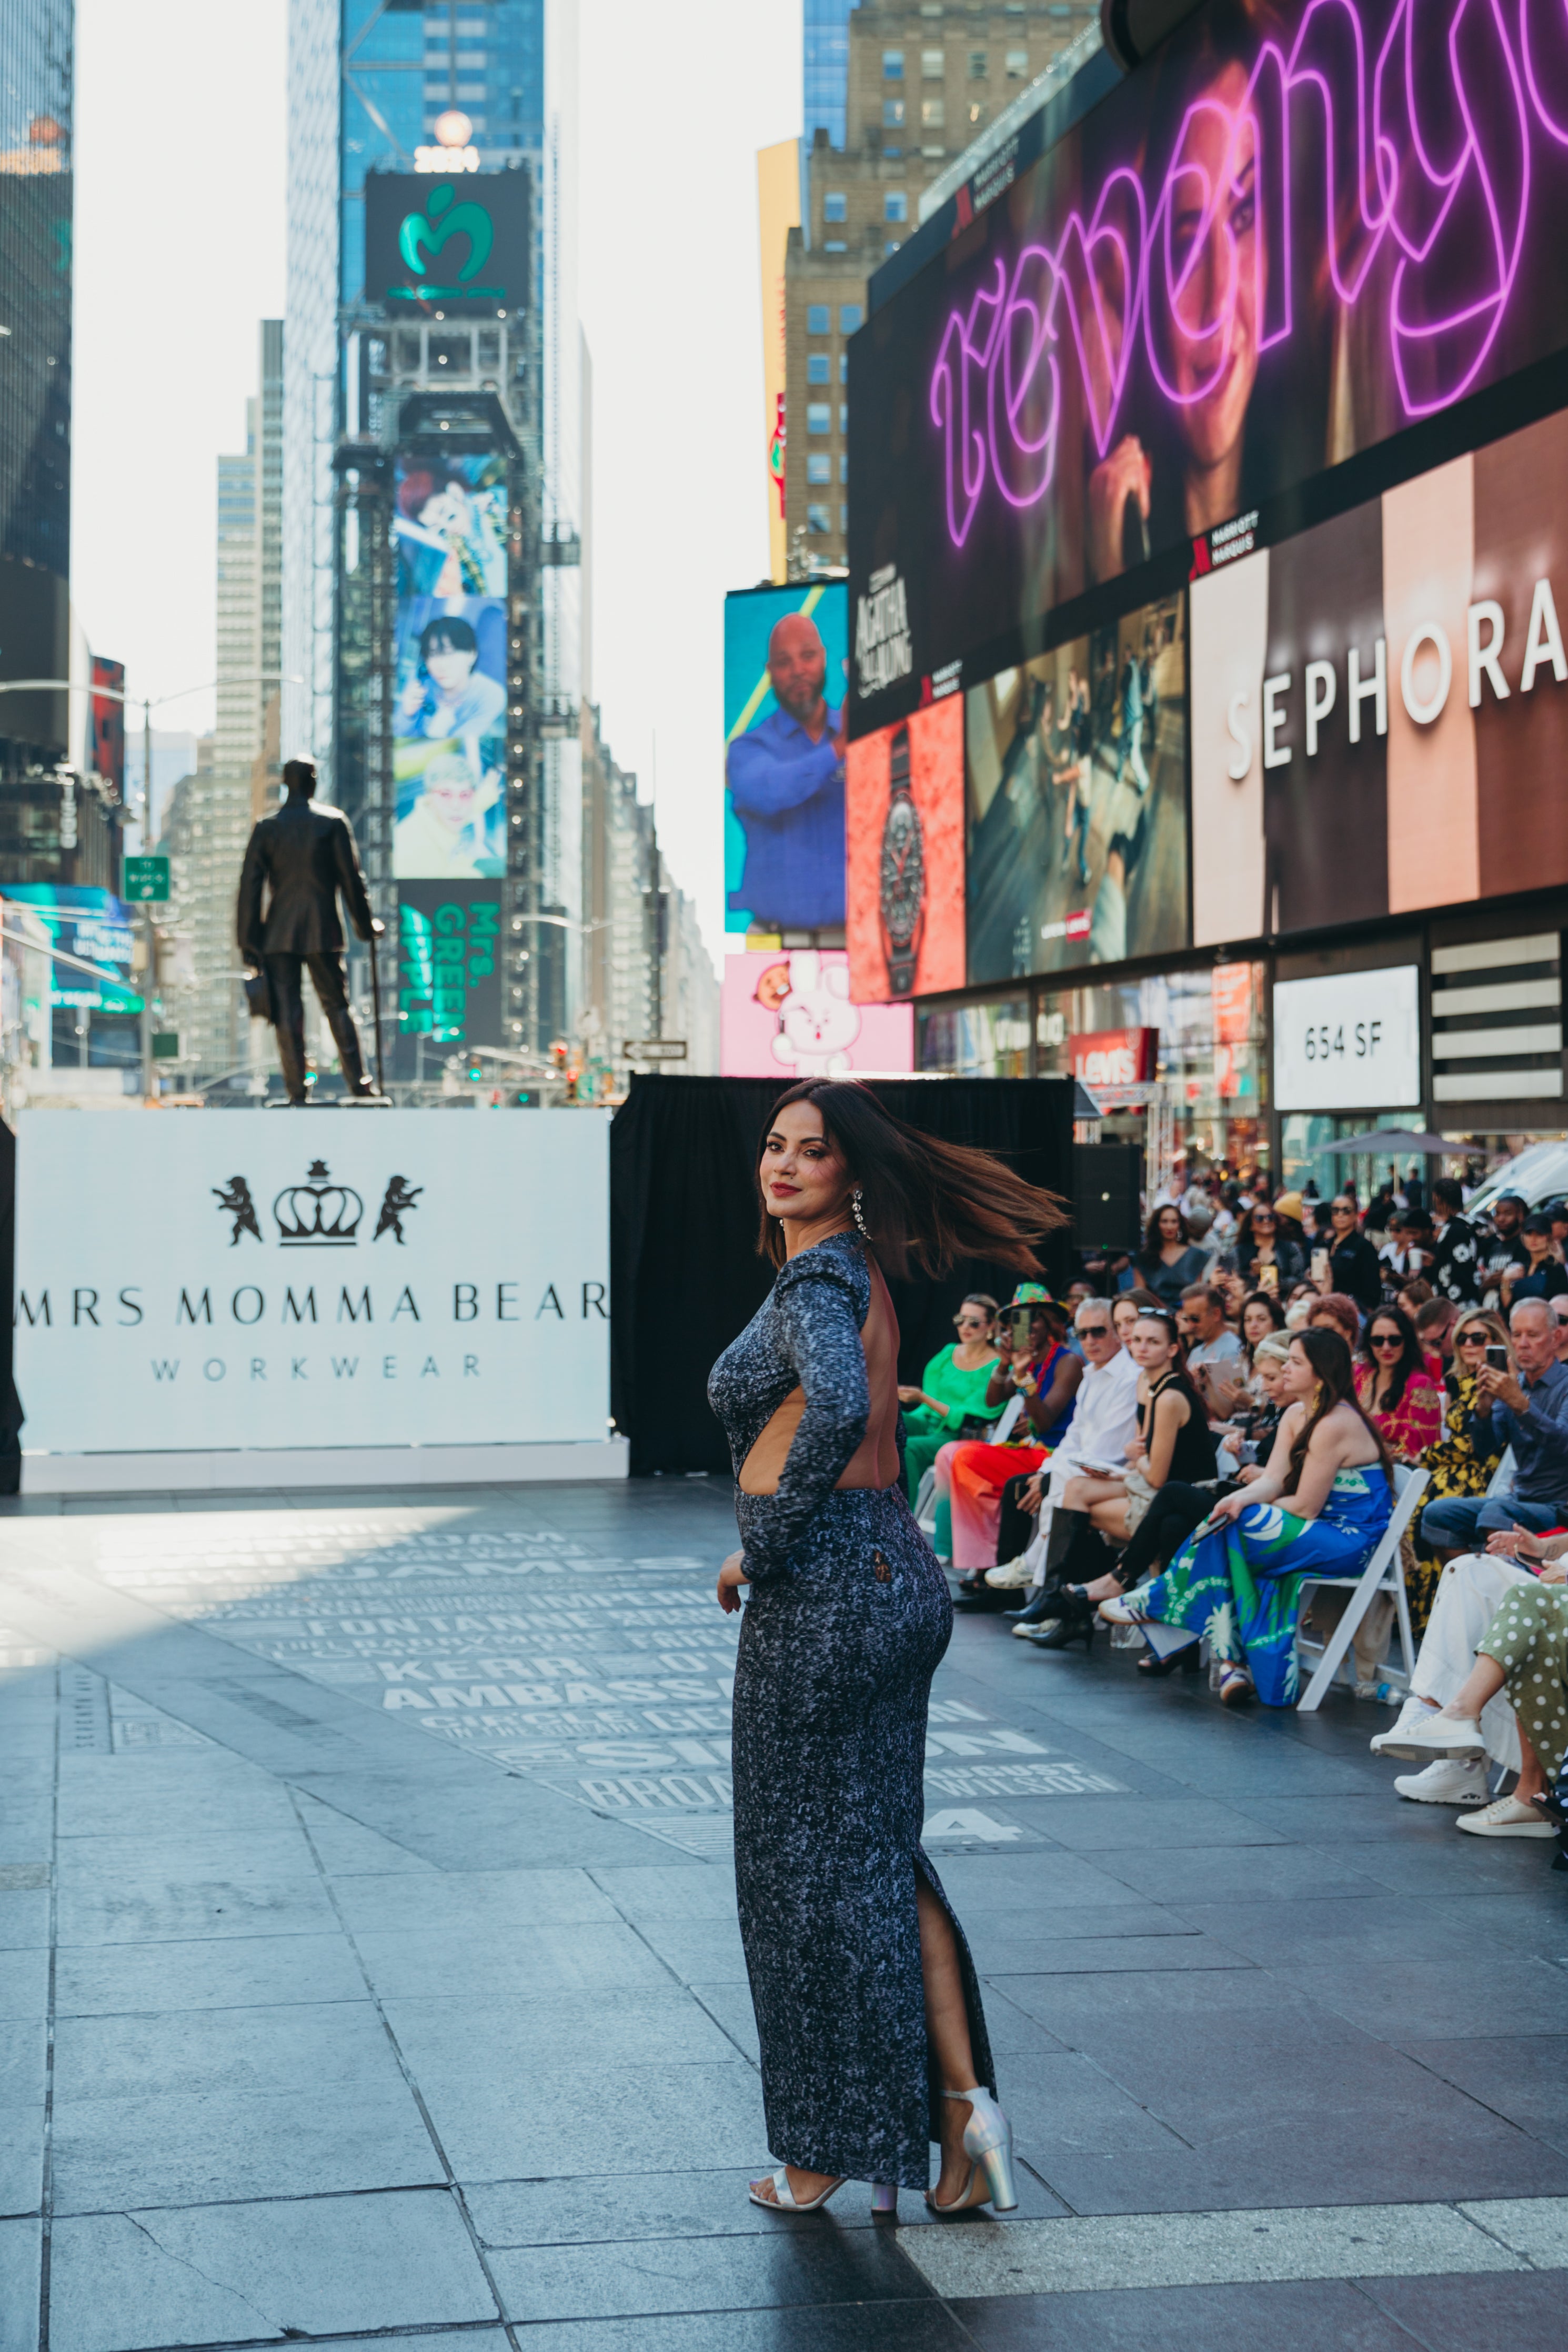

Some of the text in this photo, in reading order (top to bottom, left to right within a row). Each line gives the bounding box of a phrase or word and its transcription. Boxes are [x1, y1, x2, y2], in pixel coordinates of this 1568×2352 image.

[931, 0, 1568, 547] reveng
[1212, 509, 1259, 548] MARRIOTT
[1212, 531, 1254, 567] MARQUIS
[1227, 578, 1568, 782] SEPHORA
[468, 901, 500, 988] Mrs.
[398, 902, 434, 1036] APPLE
[433, 901, 467, 1043] GREEN
[1305, 1021, 1382, 1061] 654 SF
[14, 1281, 610, 1327] MRS MOMMA BEAR
[150, 1354, 481, 1382] WORKWEAR
[306, 1611, 606, 1637] FONTANNE
[376, 1656, 593, 1682] KERR
[381, 1677, 737, 1711] AMBASS
[924, 1762, 1084, 1780] AUGUST
[927, 1774, 1120, 1797] WILSON
